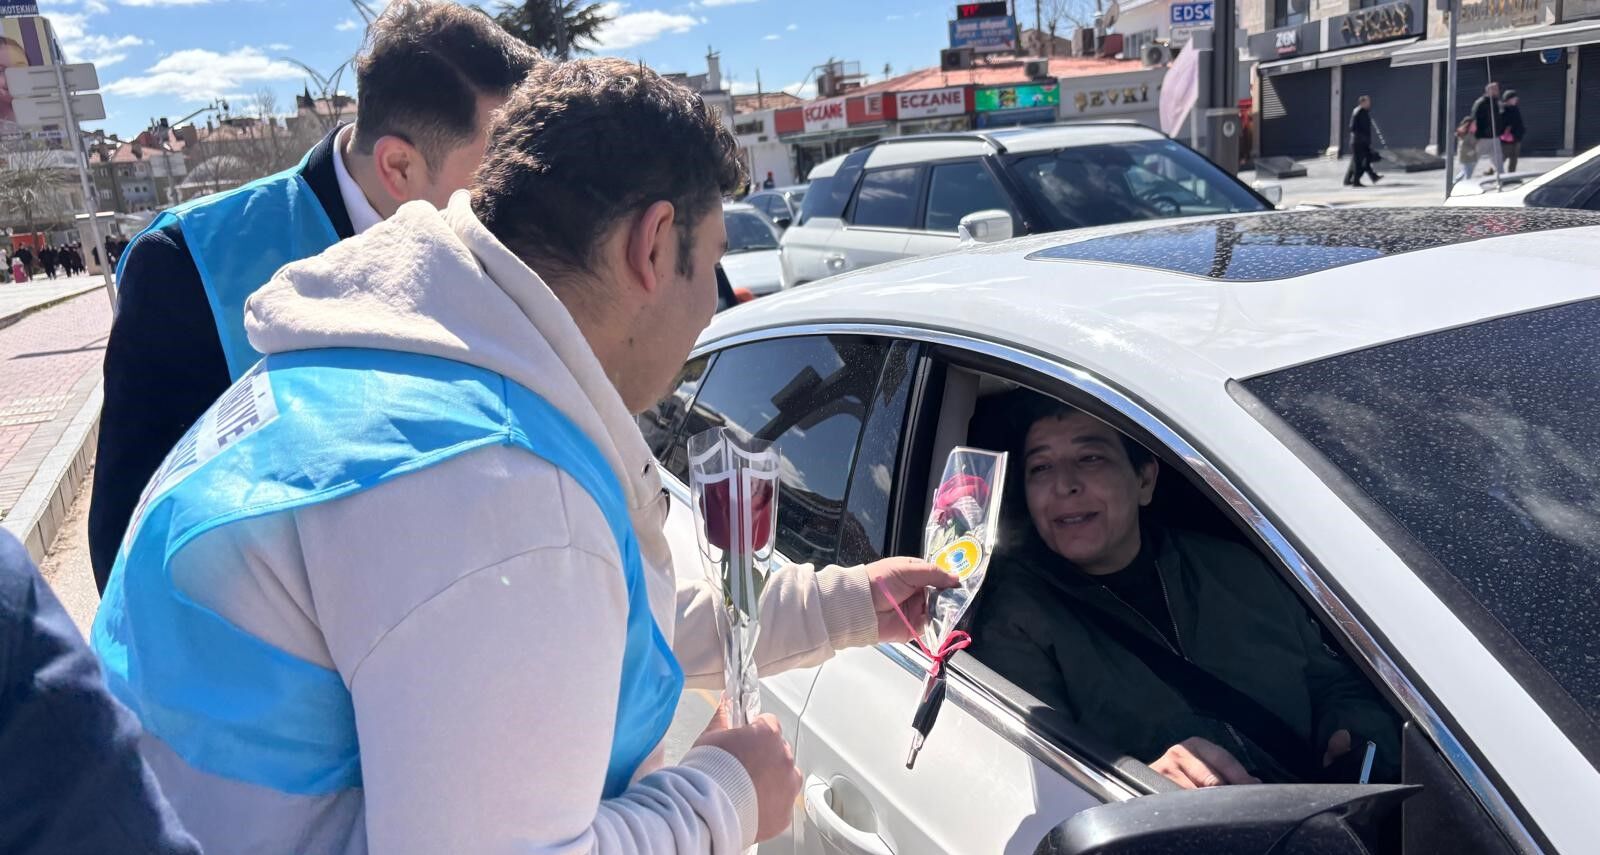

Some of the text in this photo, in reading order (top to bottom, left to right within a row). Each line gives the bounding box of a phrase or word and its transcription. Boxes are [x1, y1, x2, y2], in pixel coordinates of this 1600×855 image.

[1173, 5, 1205, 20] EDS
[901, 91, 961, 108] ECZANE
[805, 102, 843, 122] ECZANE
